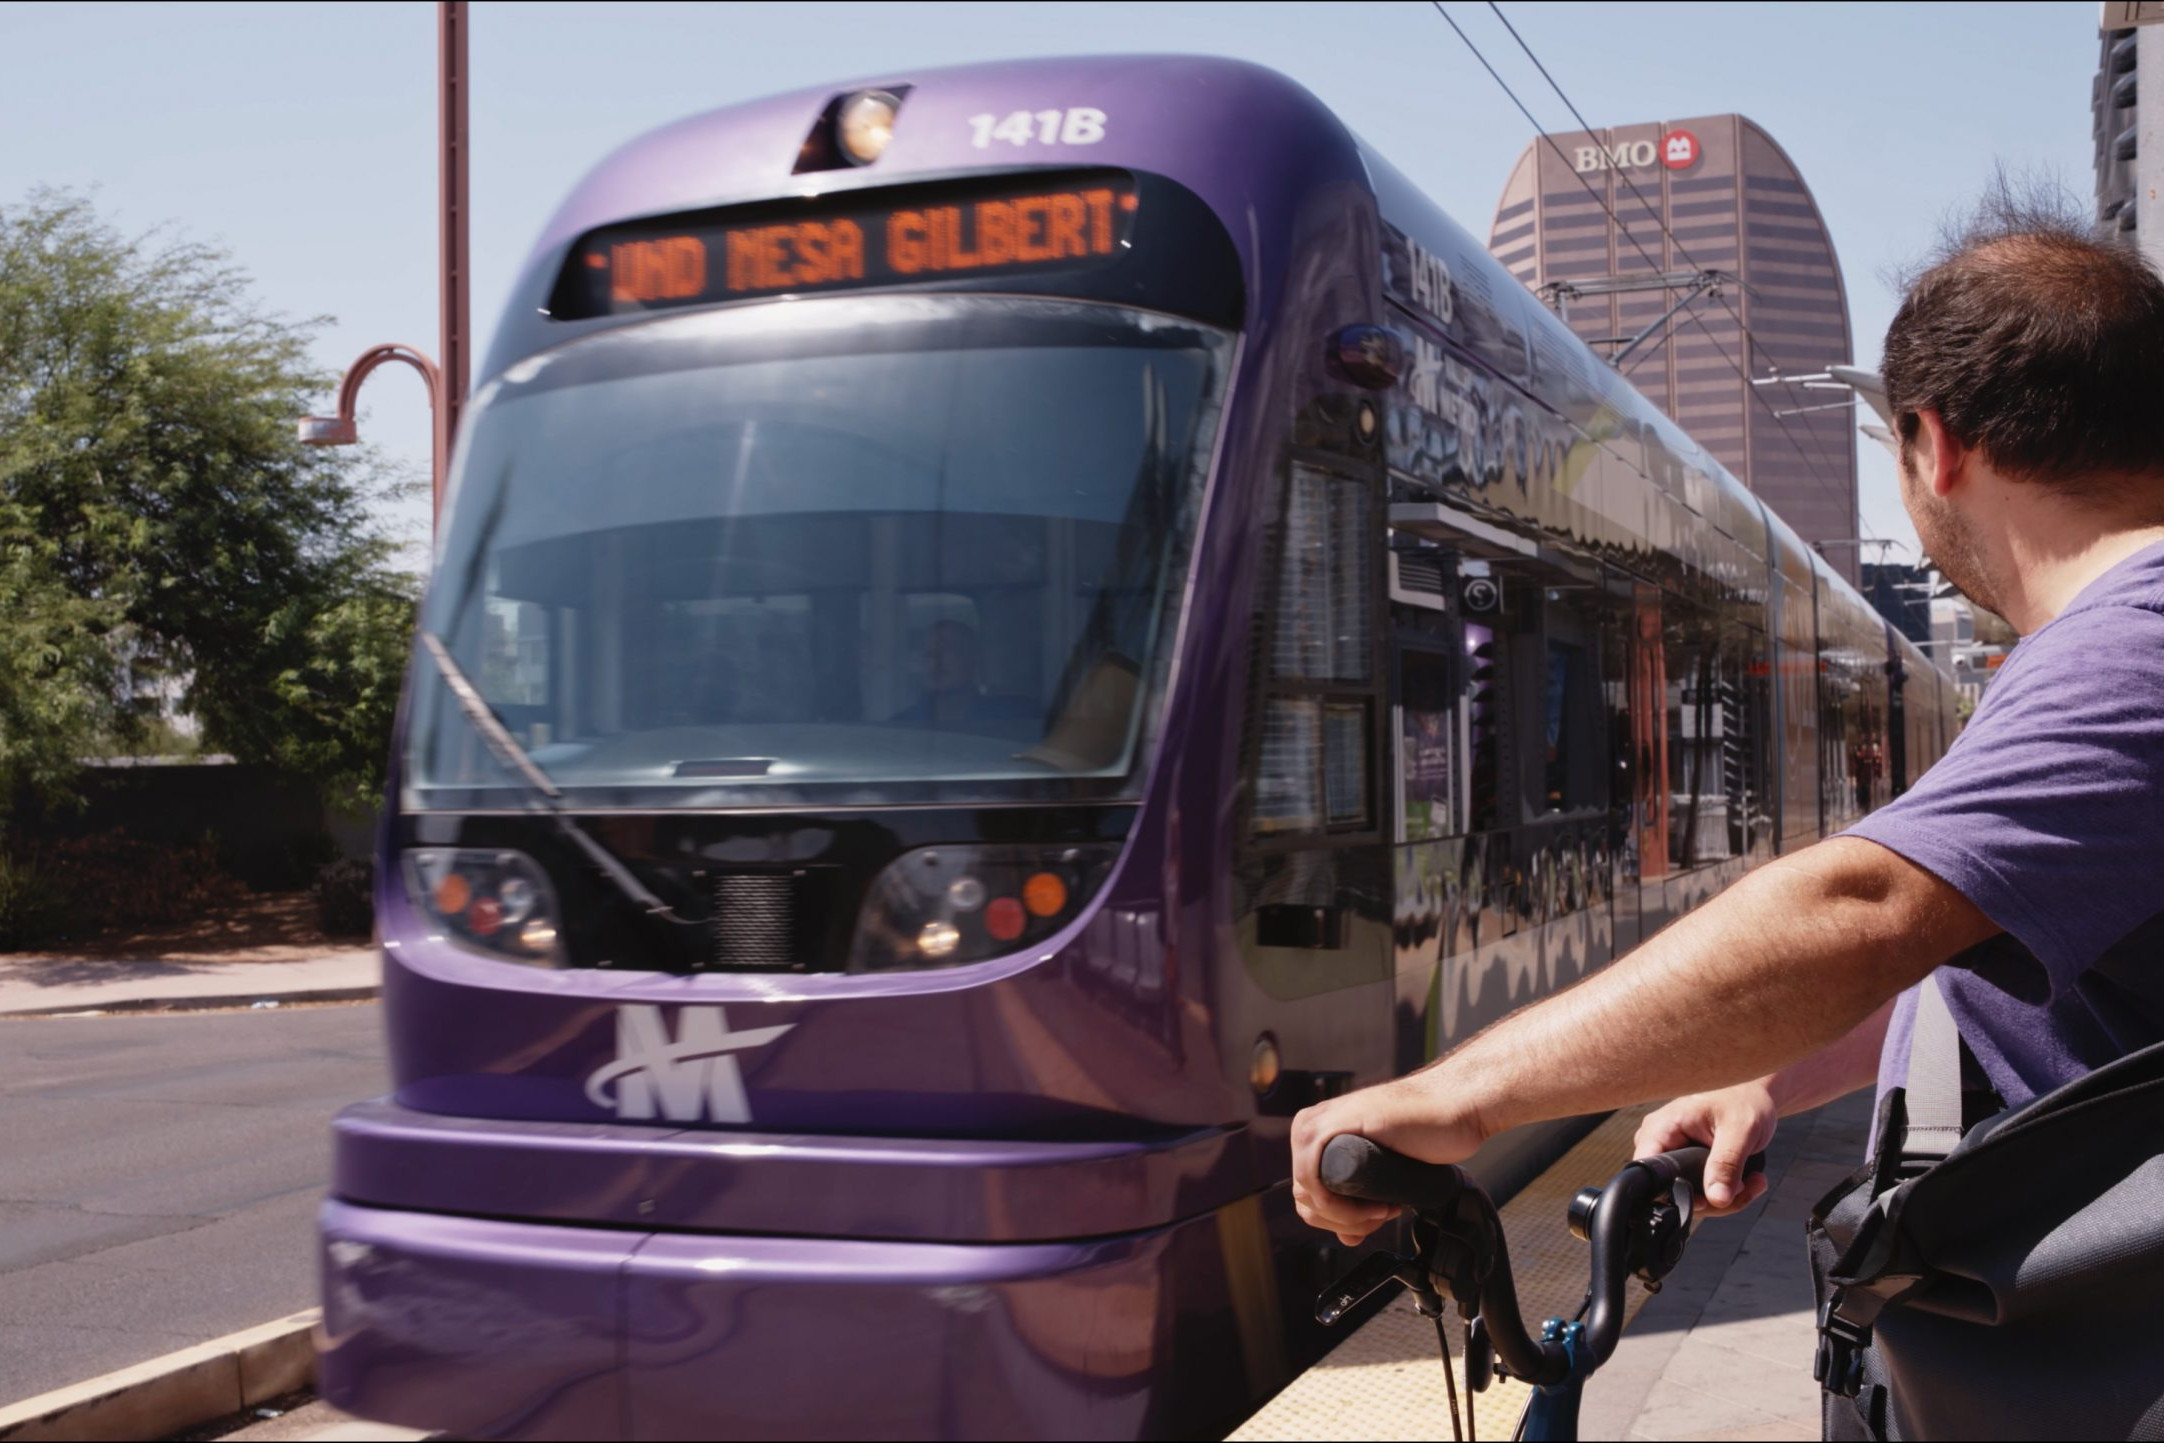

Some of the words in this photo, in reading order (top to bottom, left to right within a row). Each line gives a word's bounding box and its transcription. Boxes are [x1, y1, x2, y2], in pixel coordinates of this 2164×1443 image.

[968, 107, 1107, 149] 141B
[1575, 140, 1657, 172] BMO
[886, 188, 1113, 273] GILBERT
